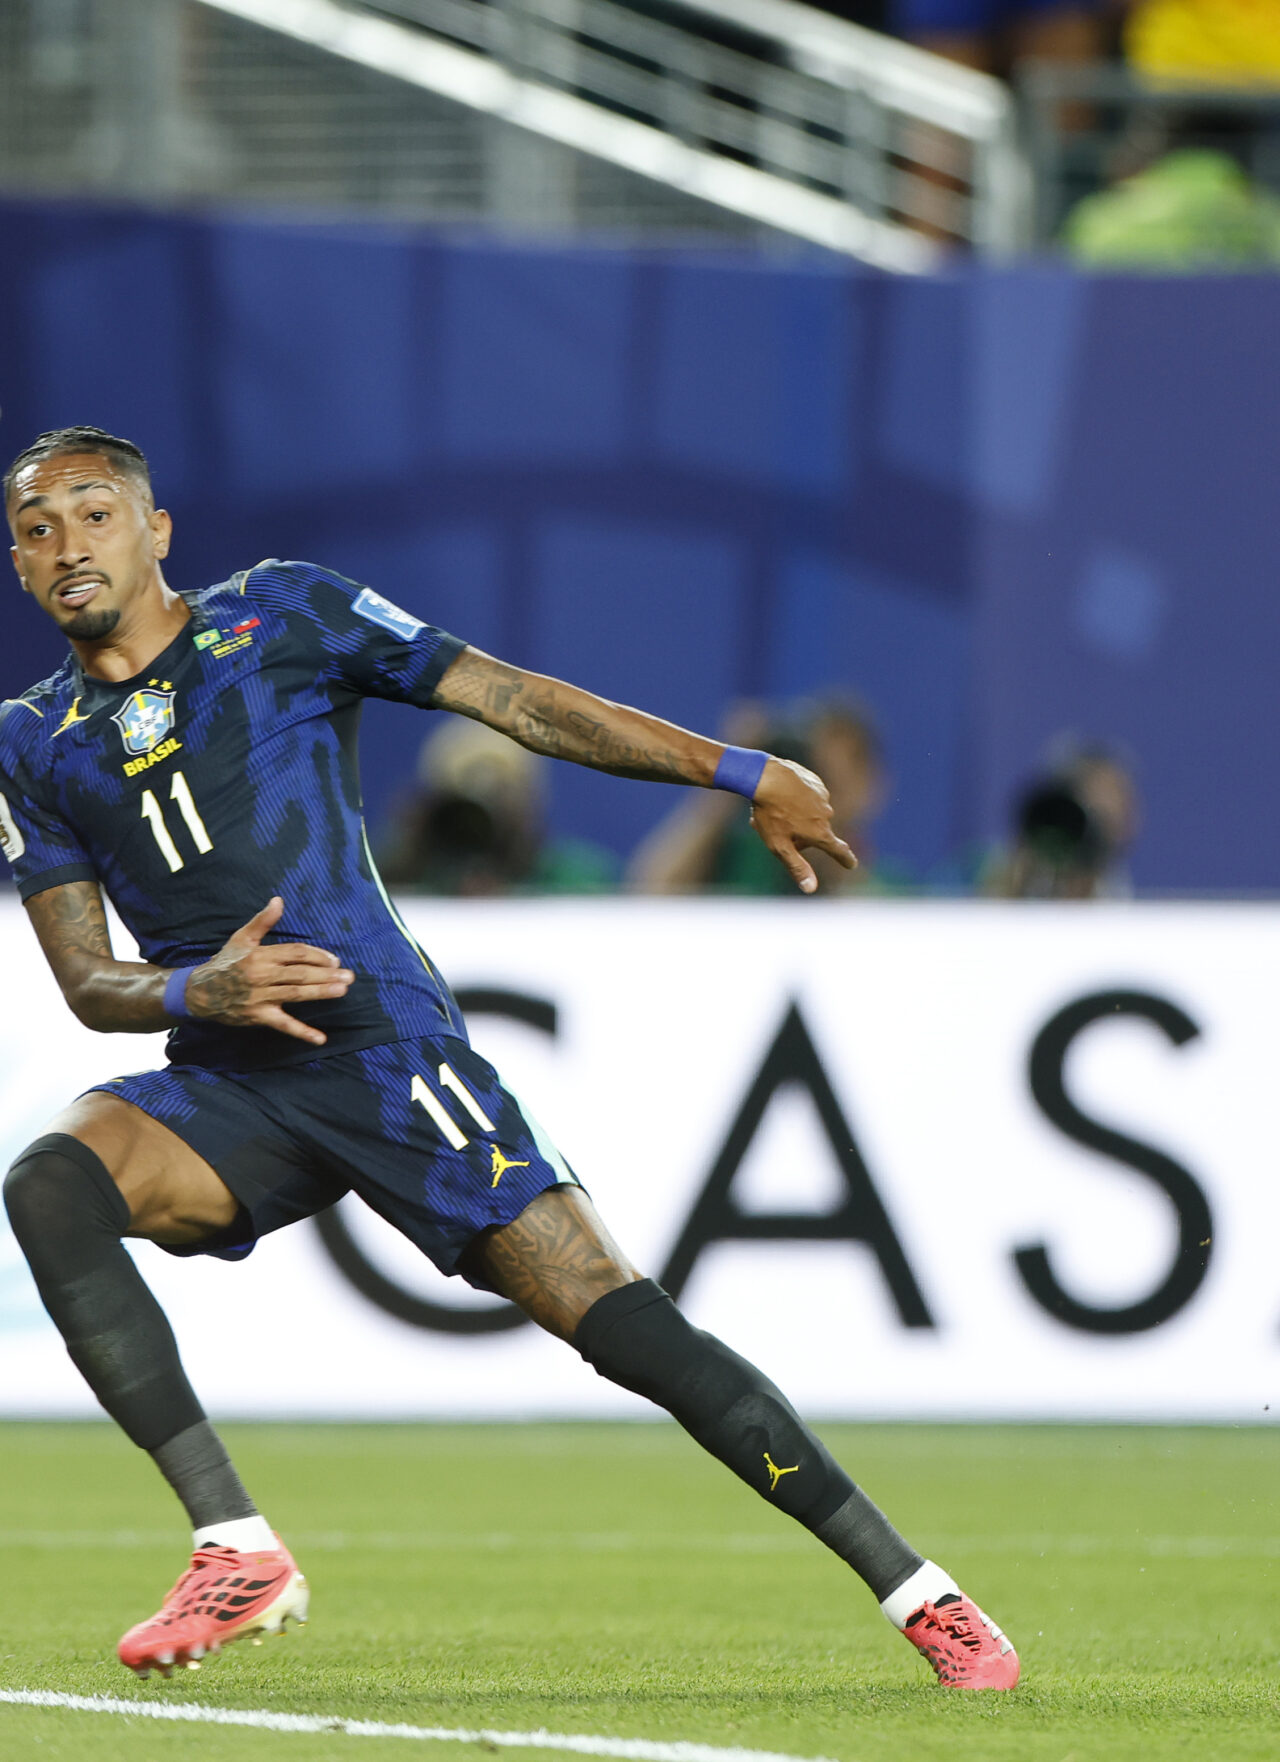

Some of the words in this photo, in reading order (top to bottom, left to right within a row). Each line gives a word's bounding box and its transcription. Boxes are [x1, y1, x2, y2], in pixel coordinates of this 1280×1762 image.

[122, 737, 183, 777] BRASIL
[141, 770, 214, 873] 11
[410, 1062, 497, 1151] 11
[312, 986, 1280, 1337] CAS
